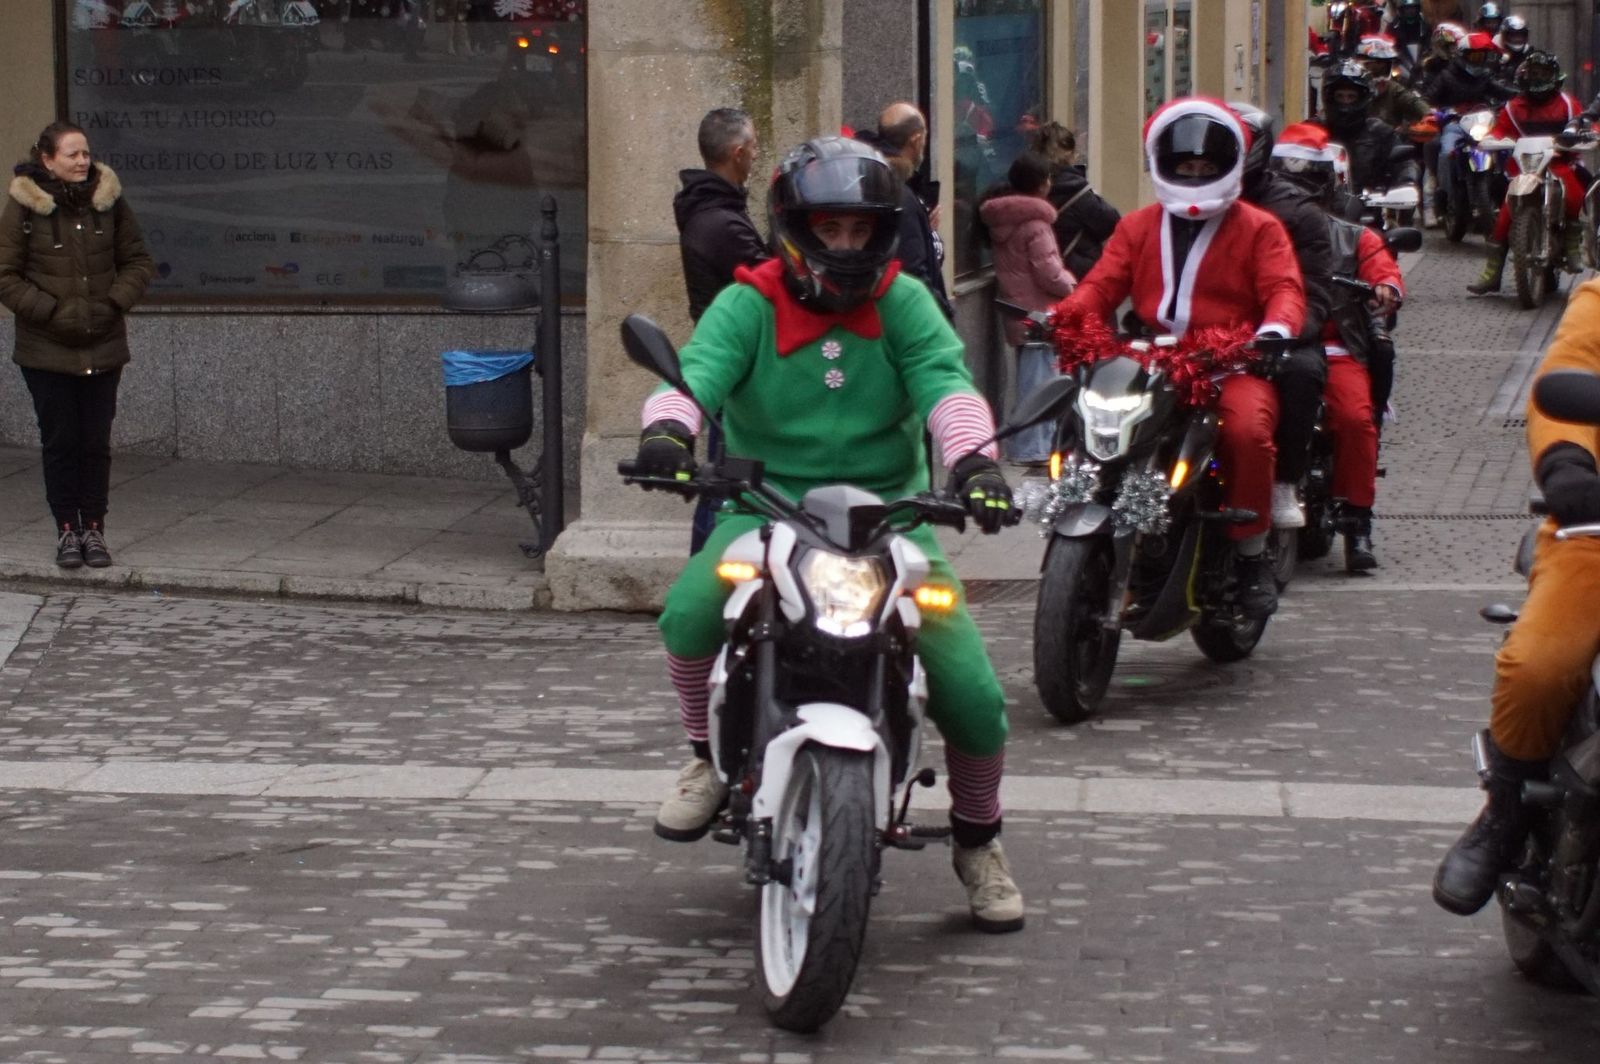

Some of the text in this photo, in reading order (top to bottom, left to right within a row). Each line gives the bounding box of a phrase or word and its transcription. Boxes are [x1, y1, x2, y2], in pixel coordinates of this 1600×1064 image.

[76, 110, 277, 129] PARA TU AHORRO
[232, 152, 269, 171] DE
[275, 152, 318, 171] LUZ
[319, 152, 339, 171] Y
[346, 152, 394, 171] GAS
[235, 231, 277, 242] acciona
[371, 233, 425, 247] Naturgy
